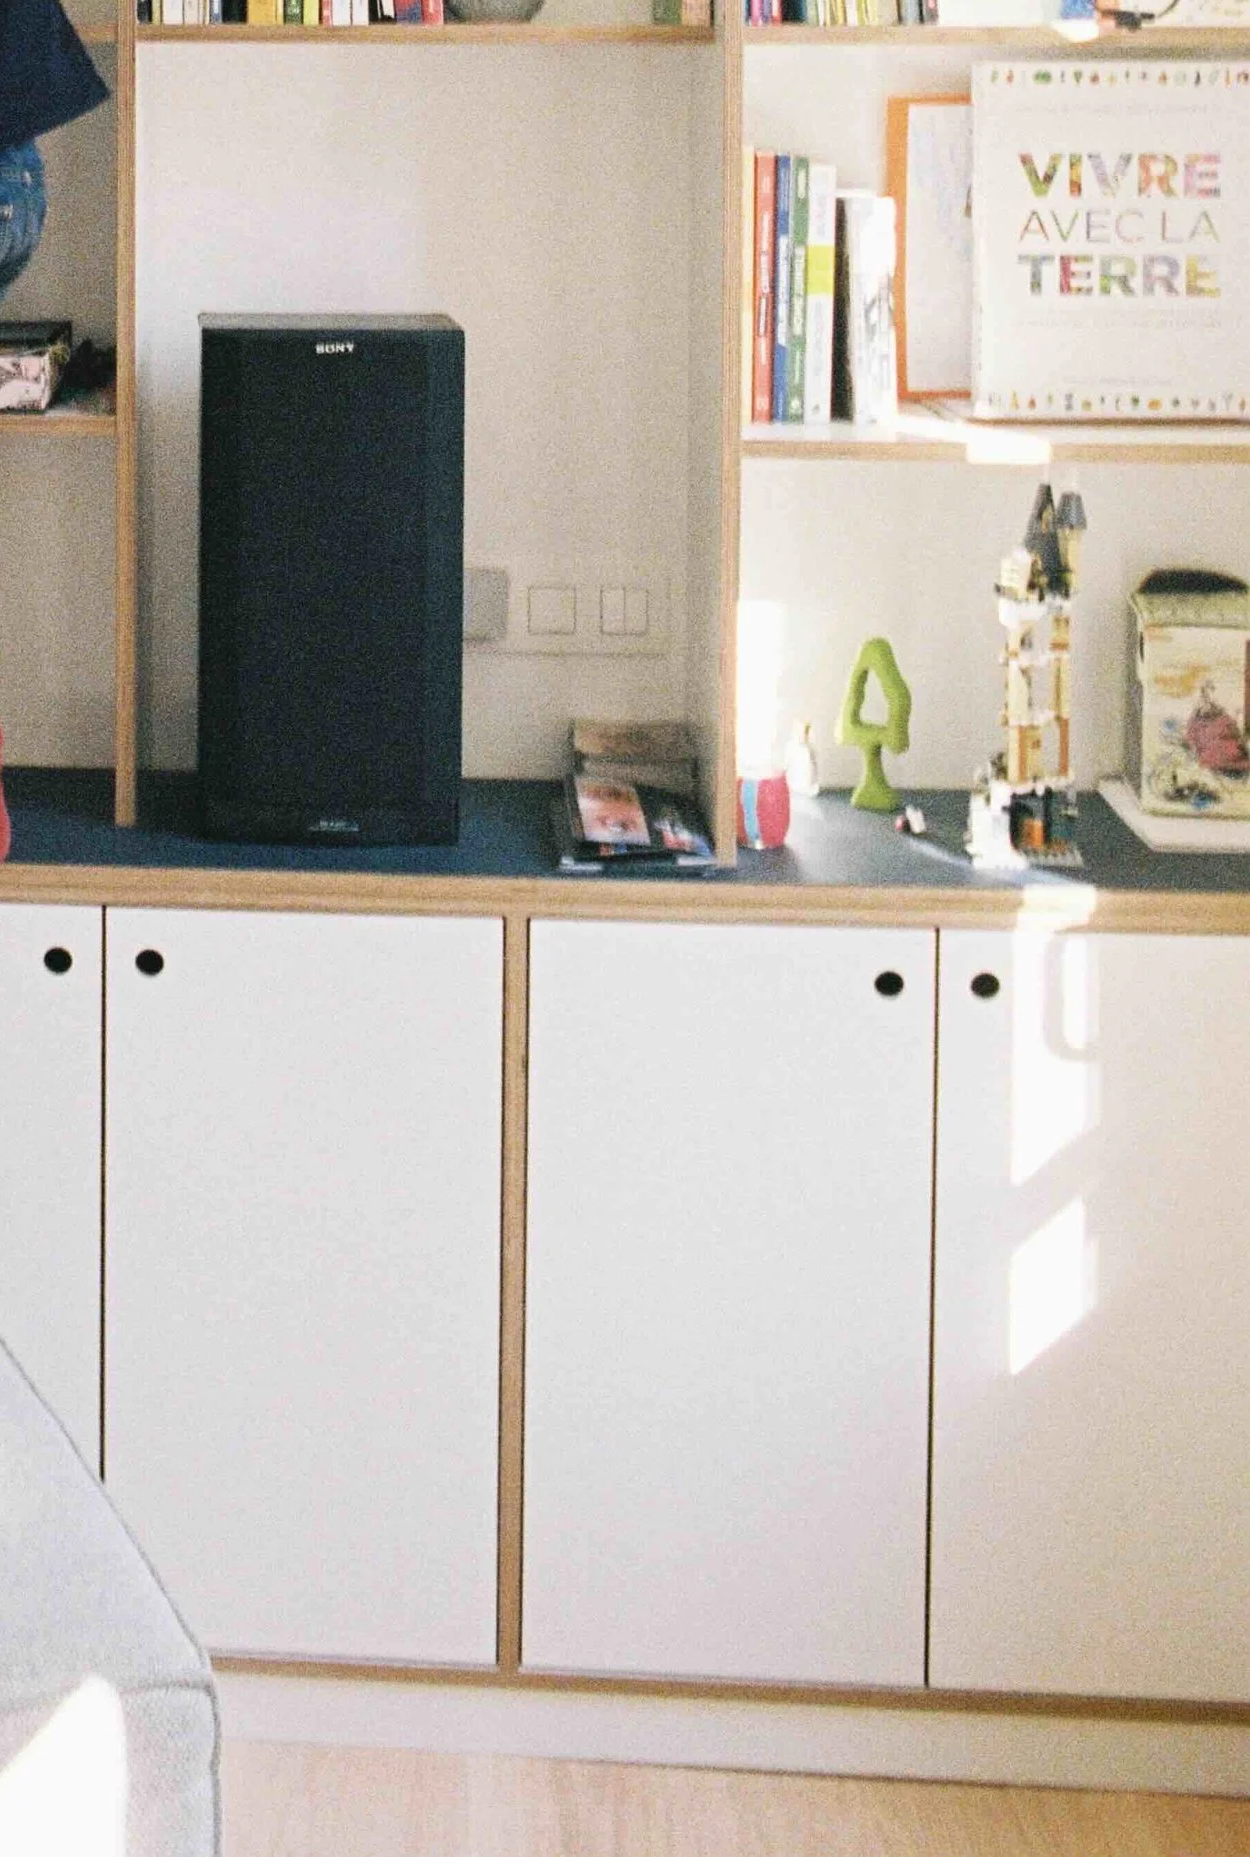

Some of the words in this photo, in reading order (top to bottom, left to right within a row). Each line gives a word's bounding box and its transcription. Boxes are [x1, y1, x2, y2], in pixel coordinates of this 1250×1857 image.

[1018, 152, 1221, 198] VIVRE
[1019, 208, 1145, 244] AVEC
[1160, 208, 1221, 244] LA
[1018, 253, 1221, 298] TERRE
[315, 343, 354, 355] SONY
